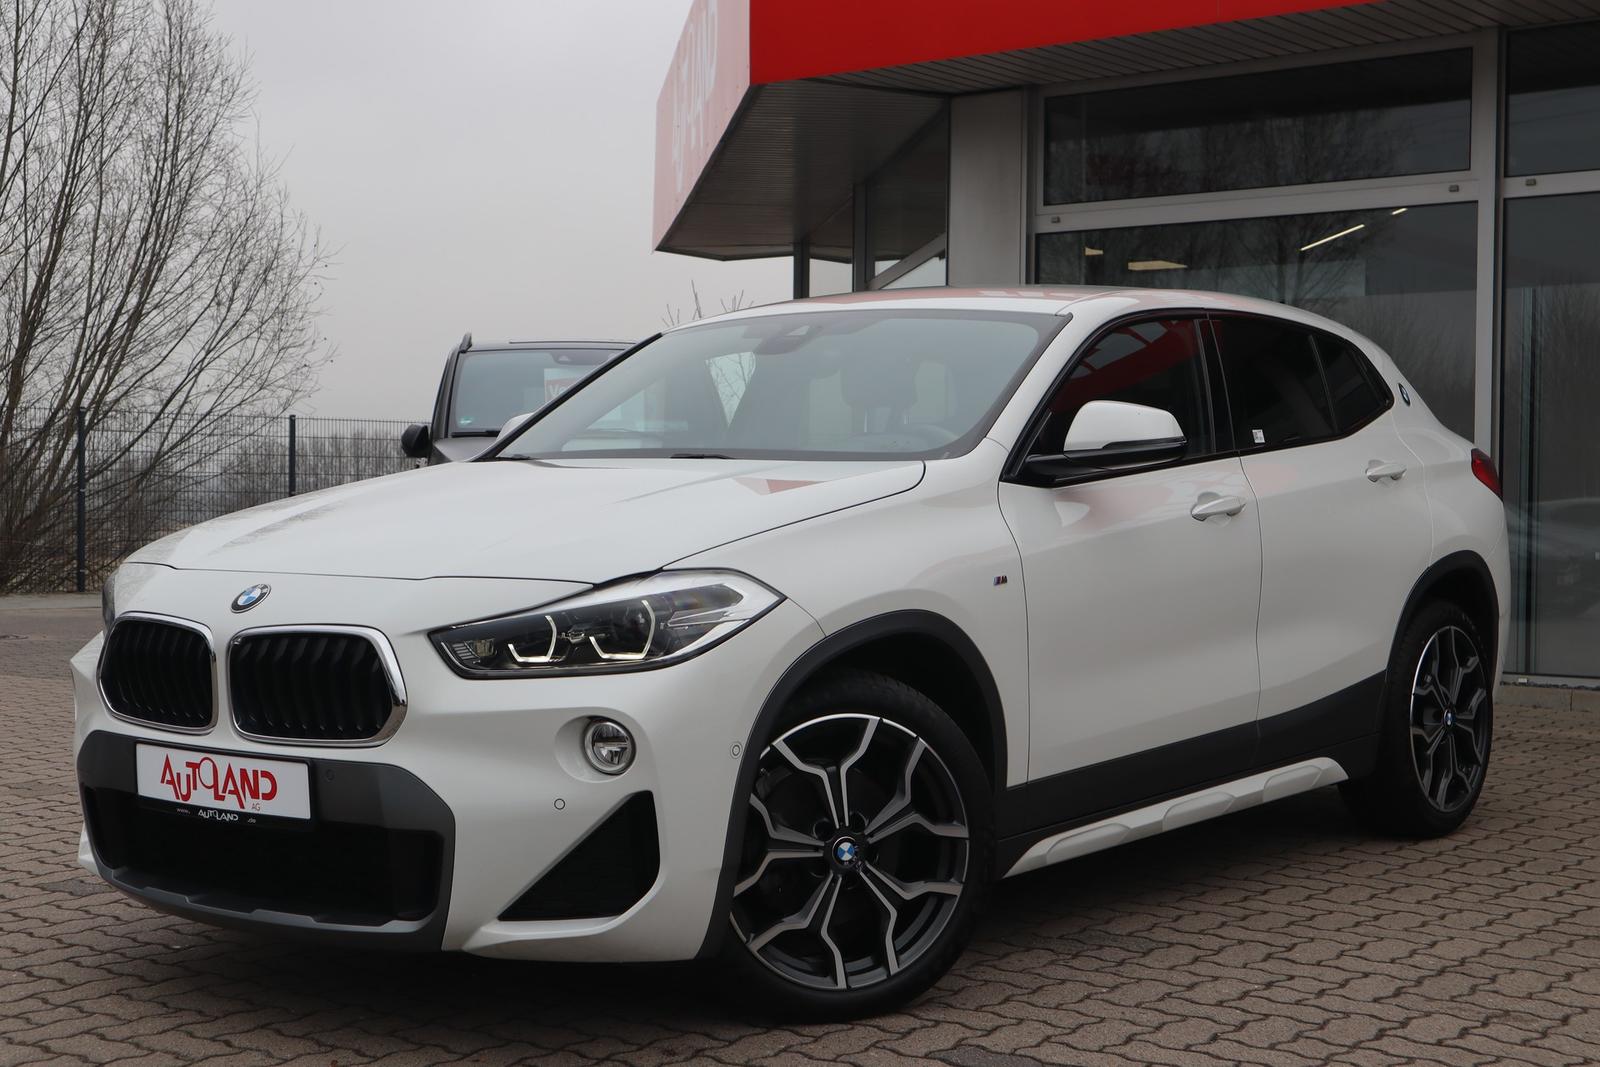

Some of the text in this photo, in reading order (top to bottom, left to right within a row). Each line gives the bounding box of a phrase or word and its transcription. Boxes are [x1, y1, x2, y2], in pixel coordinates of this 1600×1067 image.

[160, 753, 278, 809] AUTOLAND
[251, 802, 261, 812] AG
[197, 809, 239, 822] AUTOLAND
